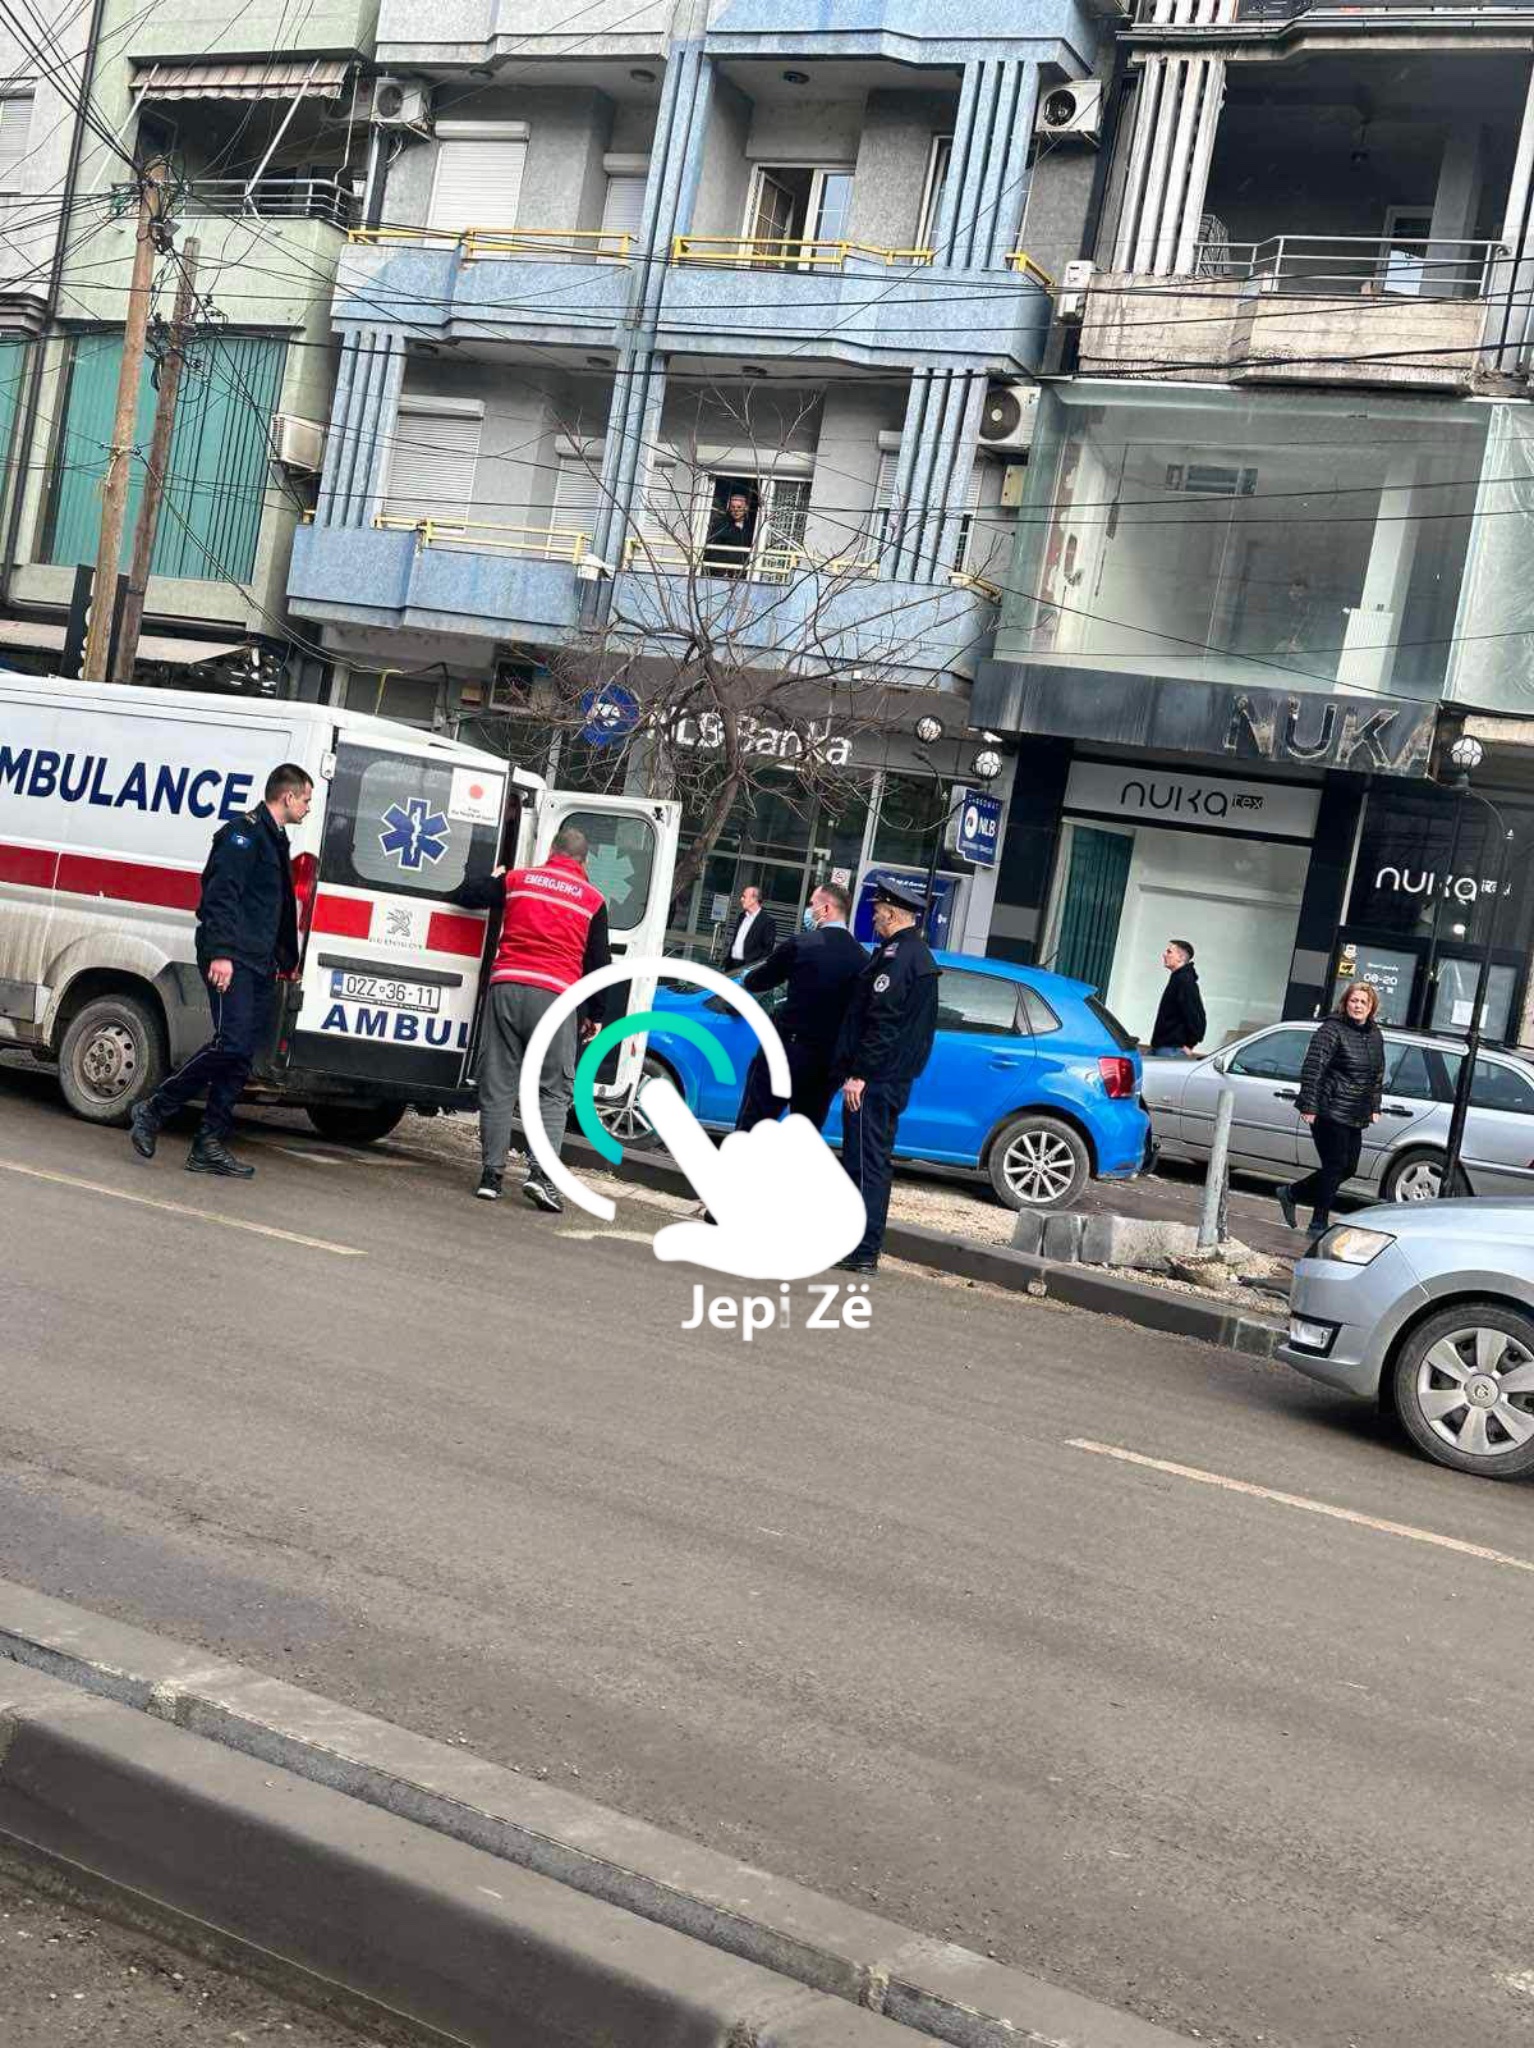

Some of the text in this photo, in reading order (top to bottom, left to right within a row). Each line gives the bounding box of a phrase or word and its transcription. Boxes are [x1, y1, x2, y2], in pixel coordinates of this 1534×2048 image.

[0, 745, 254, 821] MBULANCE
[1120, 781, 1228, 818] nuka
[977, 816, 997, 838] NLB
